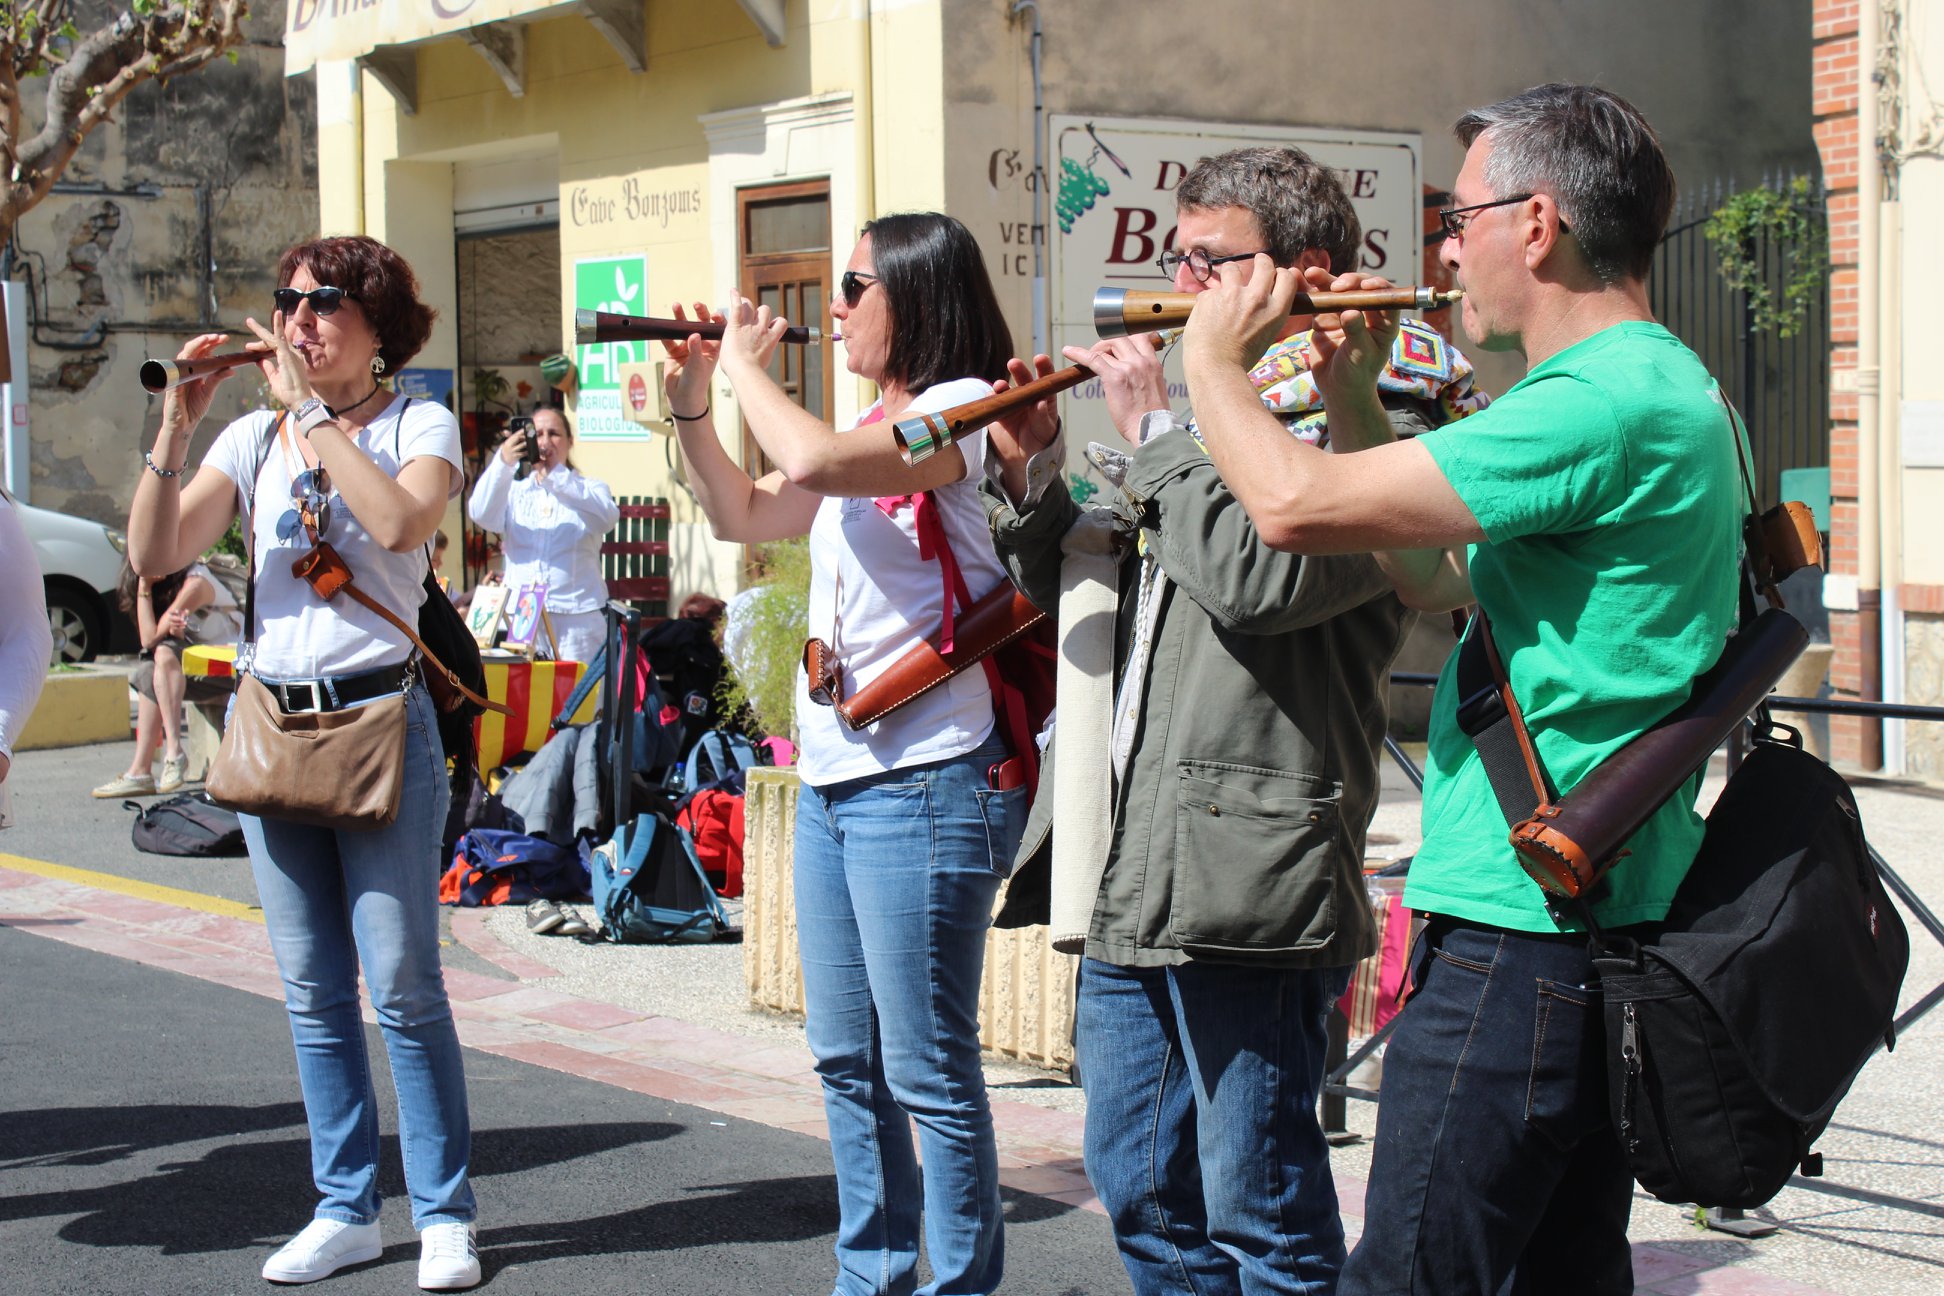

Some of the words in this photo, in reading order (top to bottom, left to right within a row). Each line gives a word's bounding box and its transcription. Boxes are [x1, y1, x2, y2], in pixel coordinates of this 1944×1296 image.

[571, 187, 615, 227] Cave
[622, 177, 700, 229] Bonzoms
[578, 395, 622, 410] AGRICUL
